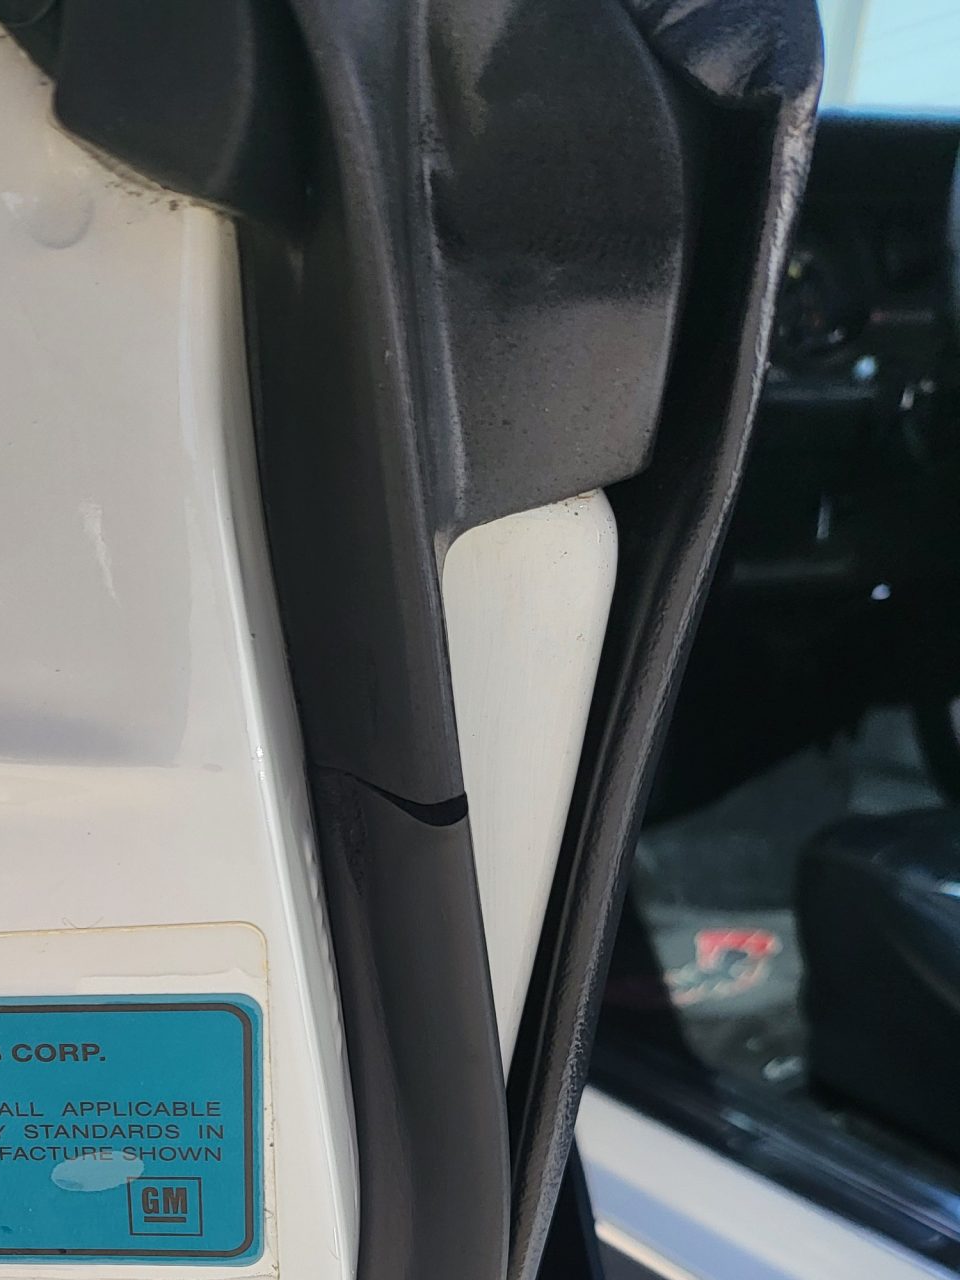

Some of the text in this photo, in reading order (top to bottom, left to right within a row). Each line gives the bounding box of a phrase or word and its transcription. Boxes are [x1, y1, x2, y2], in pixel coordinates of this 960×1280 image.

[11, 1042, 106, 1063] CORP.
[61, 1101, 222, 1117] APPLICABLE
[23, 1124, 180, 1139] STANDARDS
[198, 1124, 224, 1139] IN
[122, 1146, 222, 1161] SHOWN
[141, 1186, 188, 1215] GM
